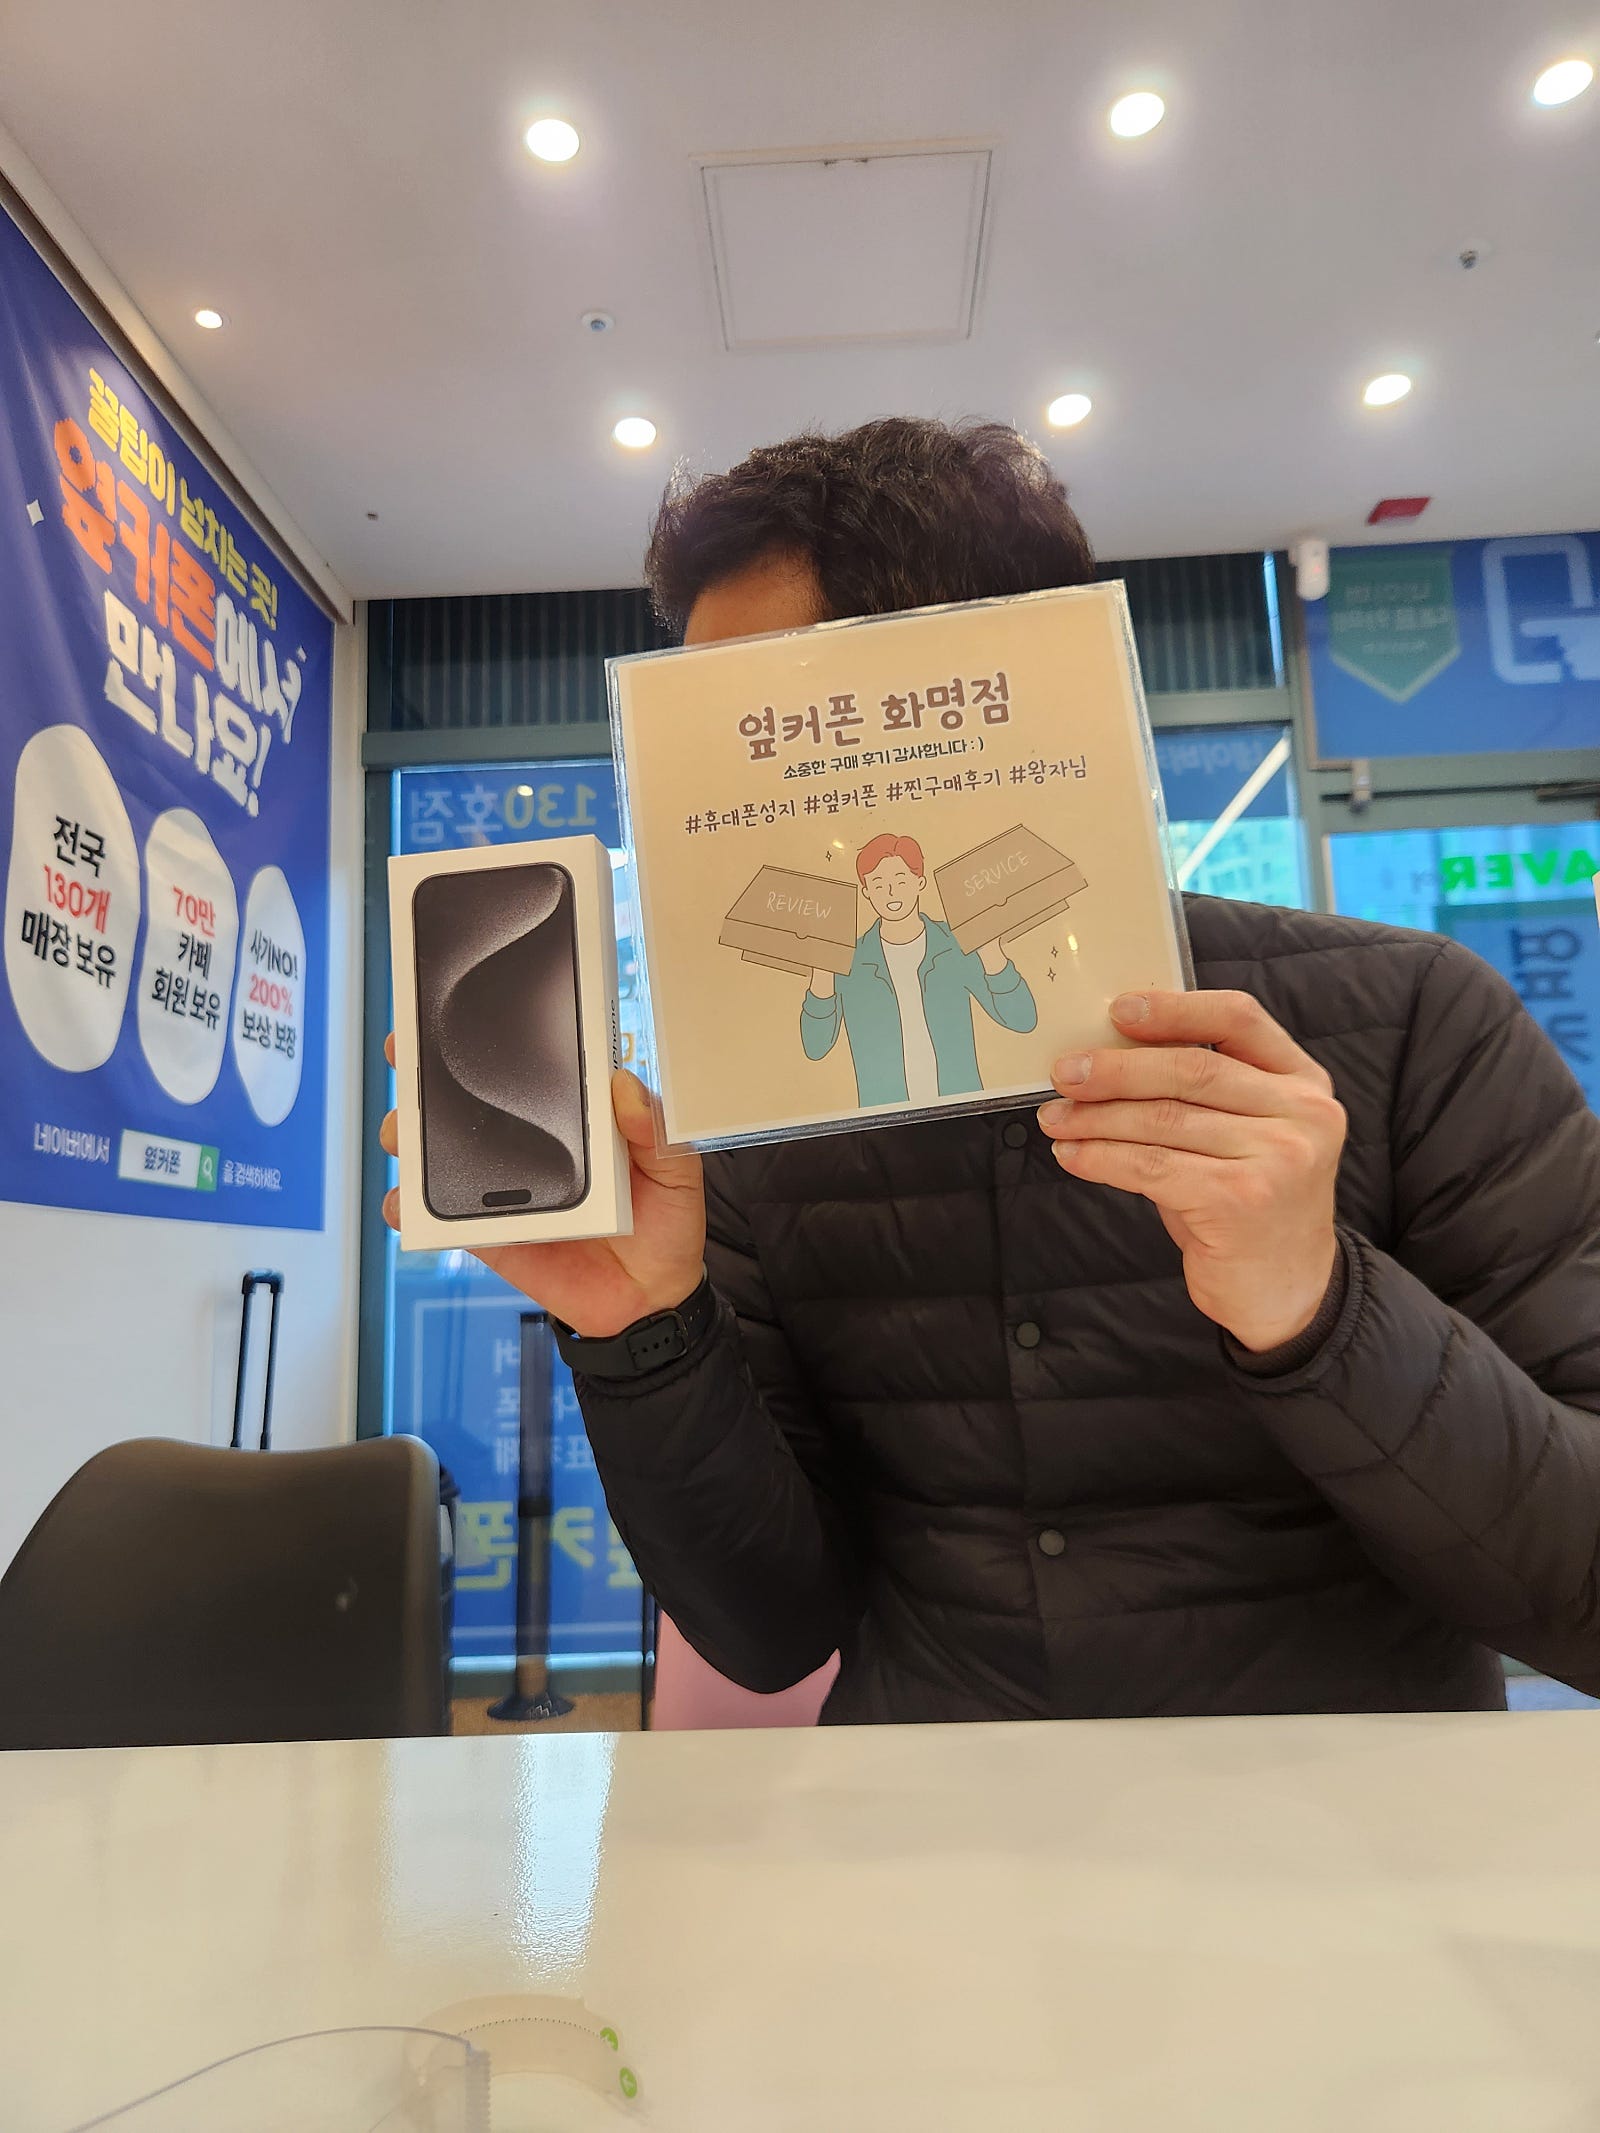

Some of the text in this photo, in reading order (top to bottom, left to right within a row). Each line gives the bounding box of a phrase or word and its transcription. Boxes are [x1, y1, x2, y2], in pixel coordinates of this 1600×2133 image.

[88, 367, 278, 631] 꿀팁이 넘치는 곳!
[104, 589, 260, 817] 만나요!
[739, 671, 1010, 761] 옆커폰 화명점
[783, 759, 827, 780] 소중한
[830, 754, 859, 772] 구매
[861, 750, 890, 766] 후기
[894, 739, 967, 763] 감사합니다
[685, 755, 1087, 834] #휴대폰성지 #옆커폰 #찐구매후기 #왕자님
[53, 814, 106, 878] 전국
[44, 864, 112, 934] 130개
[964, 850, 1031, 898] SERVICE
[173, 885, 216, 938] 70만
[765, 892, 833, 920] REVIEW
[21, 909, 116, 989] 매장 보유
[178, 932, 213, 981] 카페
[251, 928, 299, 981] 사기NO!
[151, 967, 221, 1031] 회원 보유
[249, 973, 294, 1017] 200%
[243, 1008, 298, 1060] 보상 보장
[33, 1122, 111, 1164] 네이버에서
[145, 1144, 182, 1175] 옆커폰
